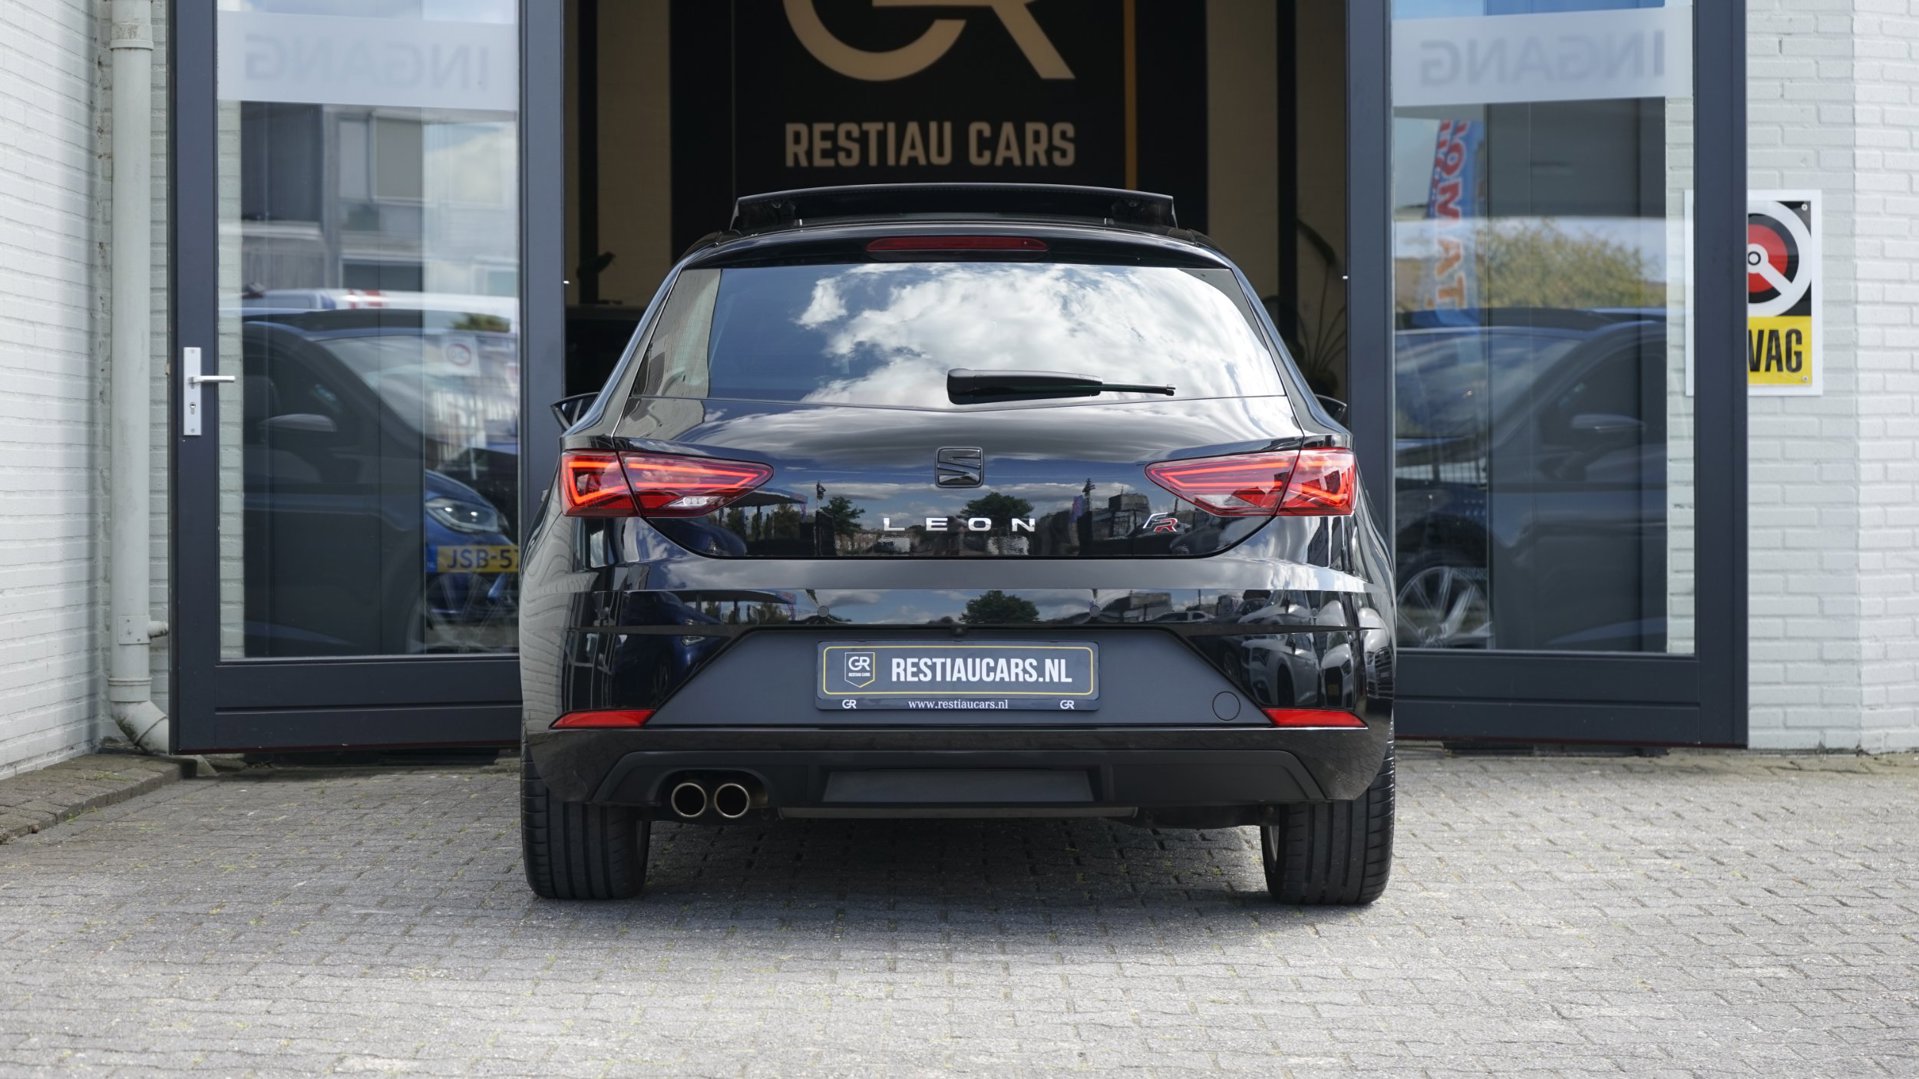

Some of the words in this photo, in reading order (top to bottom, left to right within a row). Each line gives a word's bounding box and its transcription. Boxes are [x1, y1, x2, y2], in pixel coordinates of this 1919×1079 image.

[785, 121, 952, 168] RESTIAU
[968, 121, 1076, 168] CARS
[883, 517, 1036, 532] LEON
[447, 548, 519, 569] JSB-5
[848, 656, 871, 671] GR
[891, 657, 1073, 683] RESTIAUCARS.NL
[841, 699, 857, 709] GR
[908, 699, 1009, 710] www.restiaucars.nl
[1060, 699, 1075, 710] GR
